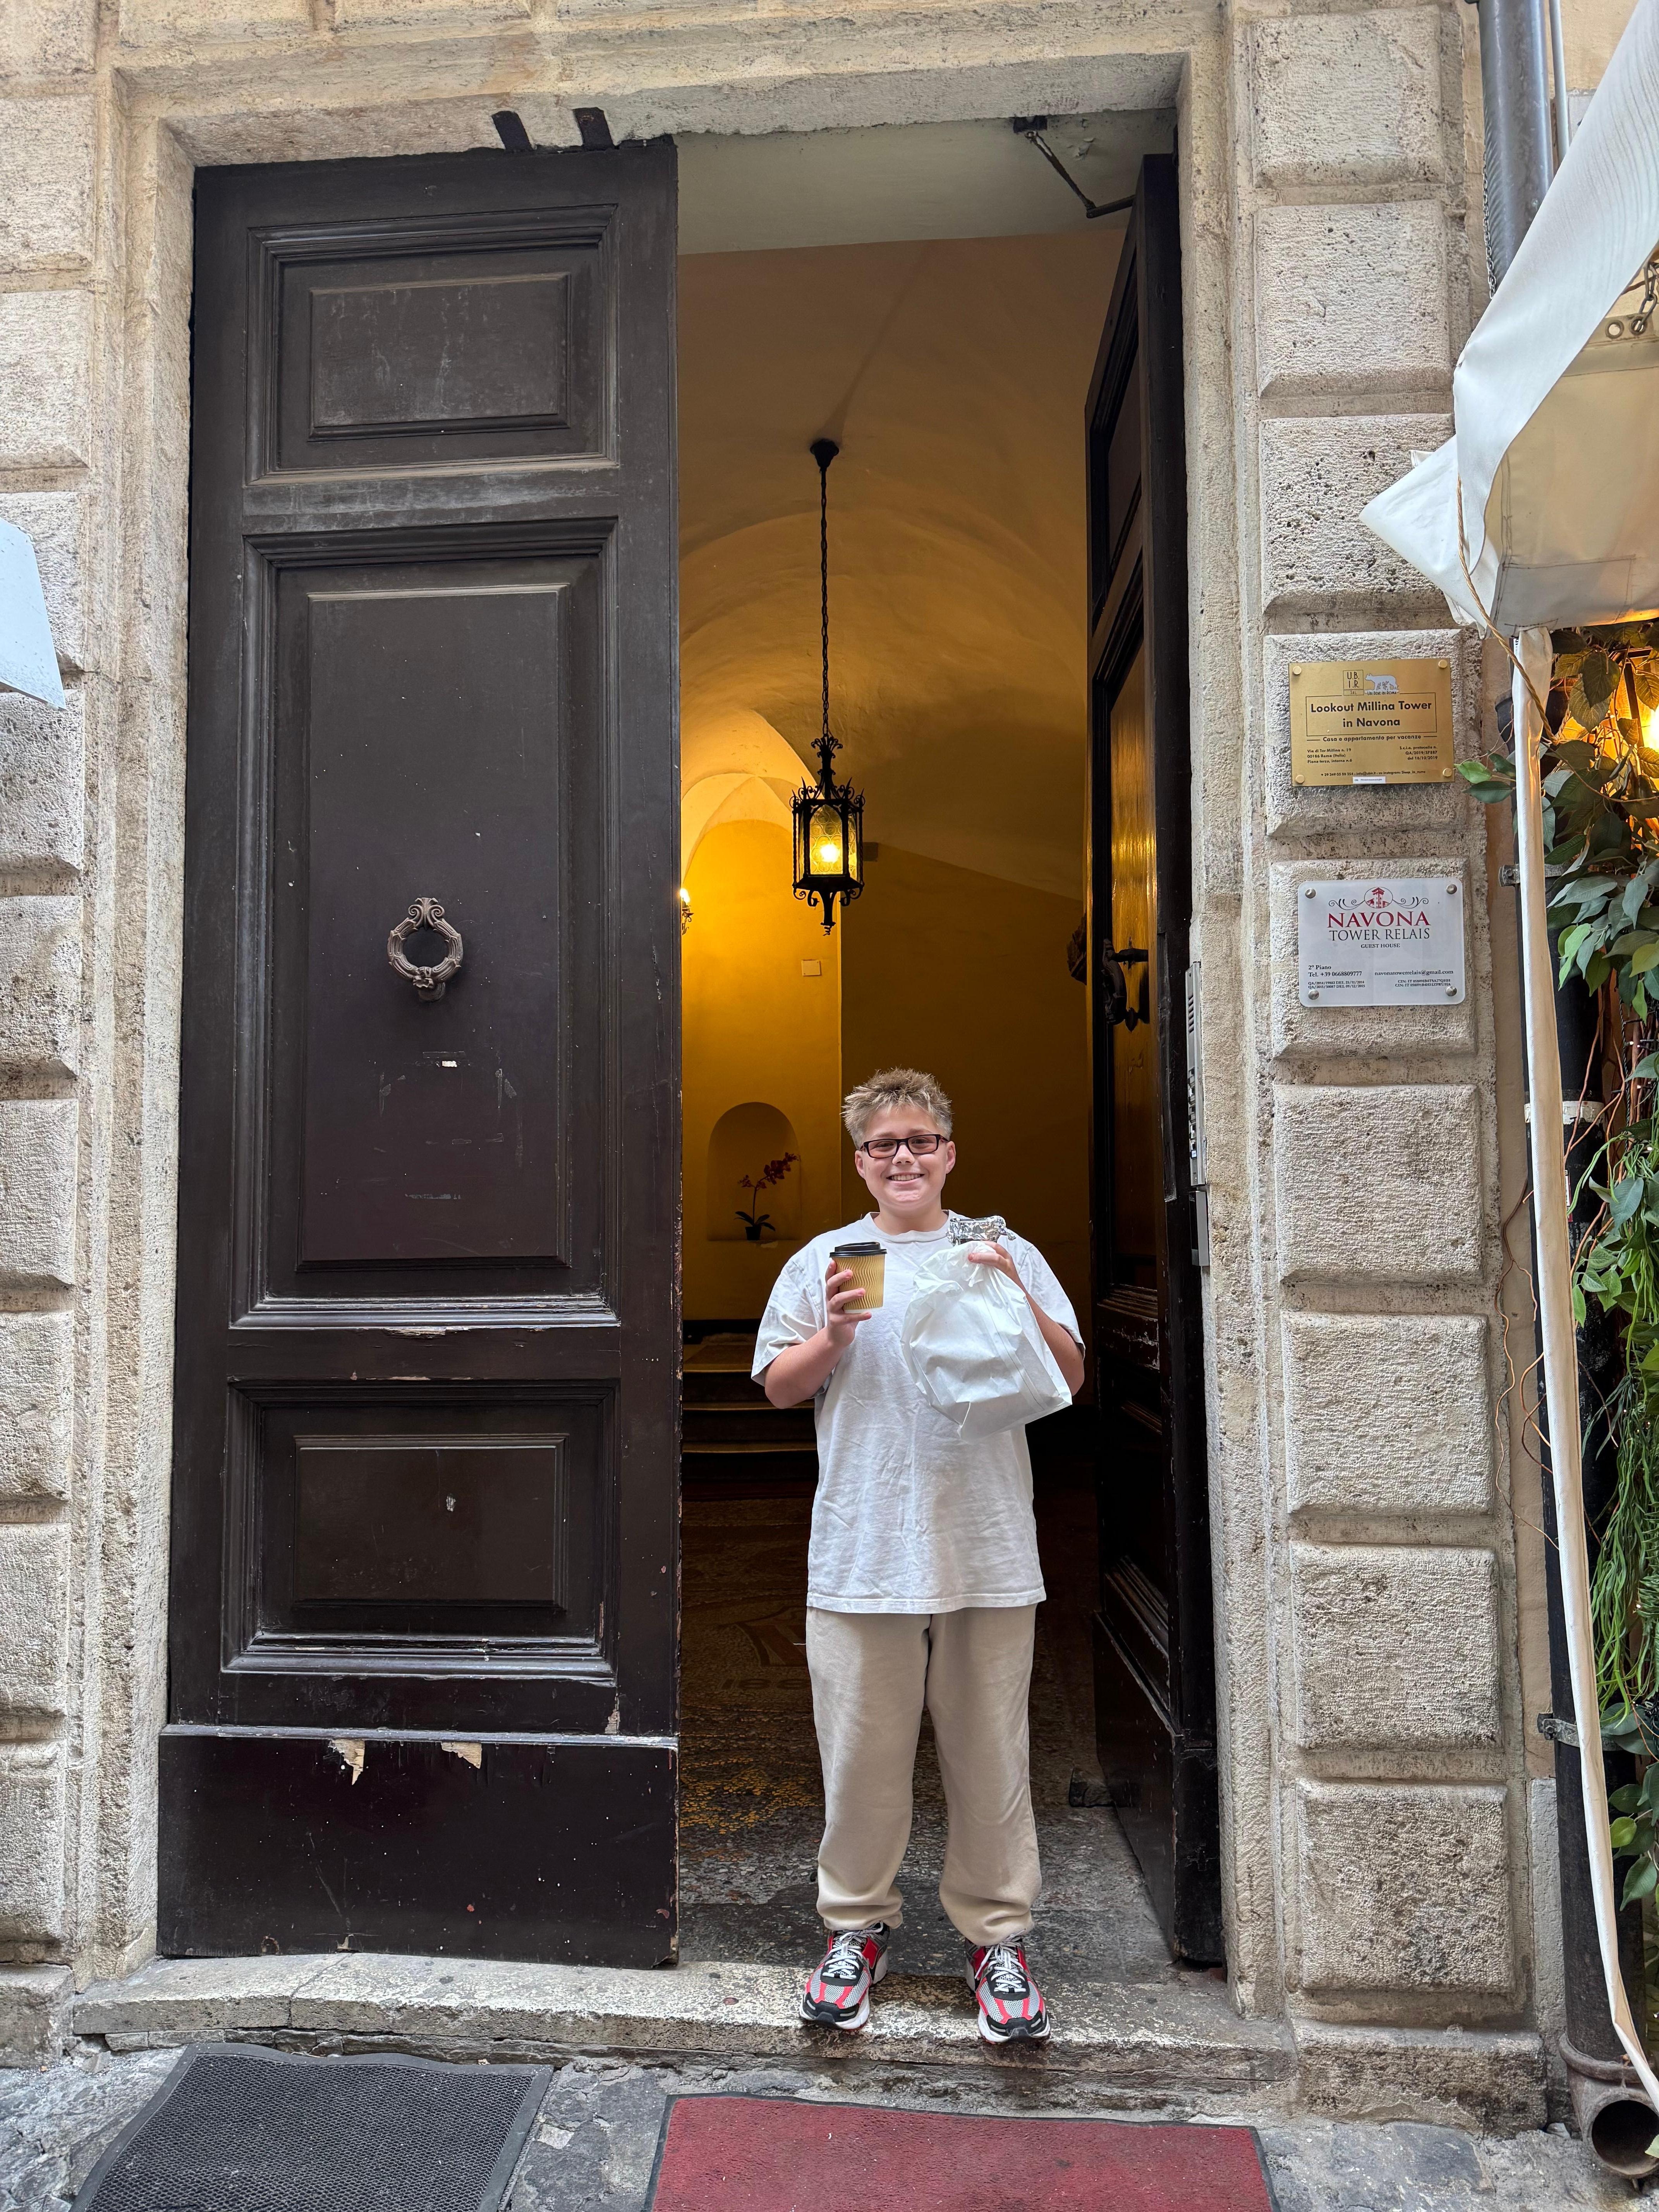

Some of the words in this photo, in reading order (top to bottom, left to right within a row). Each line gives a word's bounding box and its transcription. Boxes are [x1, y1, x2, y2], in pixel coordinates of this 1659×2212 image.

[1311, 703, 1354, 713] Lookout
[1357, 702, 1395, 711] Millina
[1398, 701, 1432, 709] Tower
[1343, 718, 1352, 727] in
[1357, 718, 1400, 726] Navona
[1328, 911, 1431, 928] NAVONA
[1329, 929, 1381, 941] TOWER
[1385, 928, 1430, 939] RELAIS
